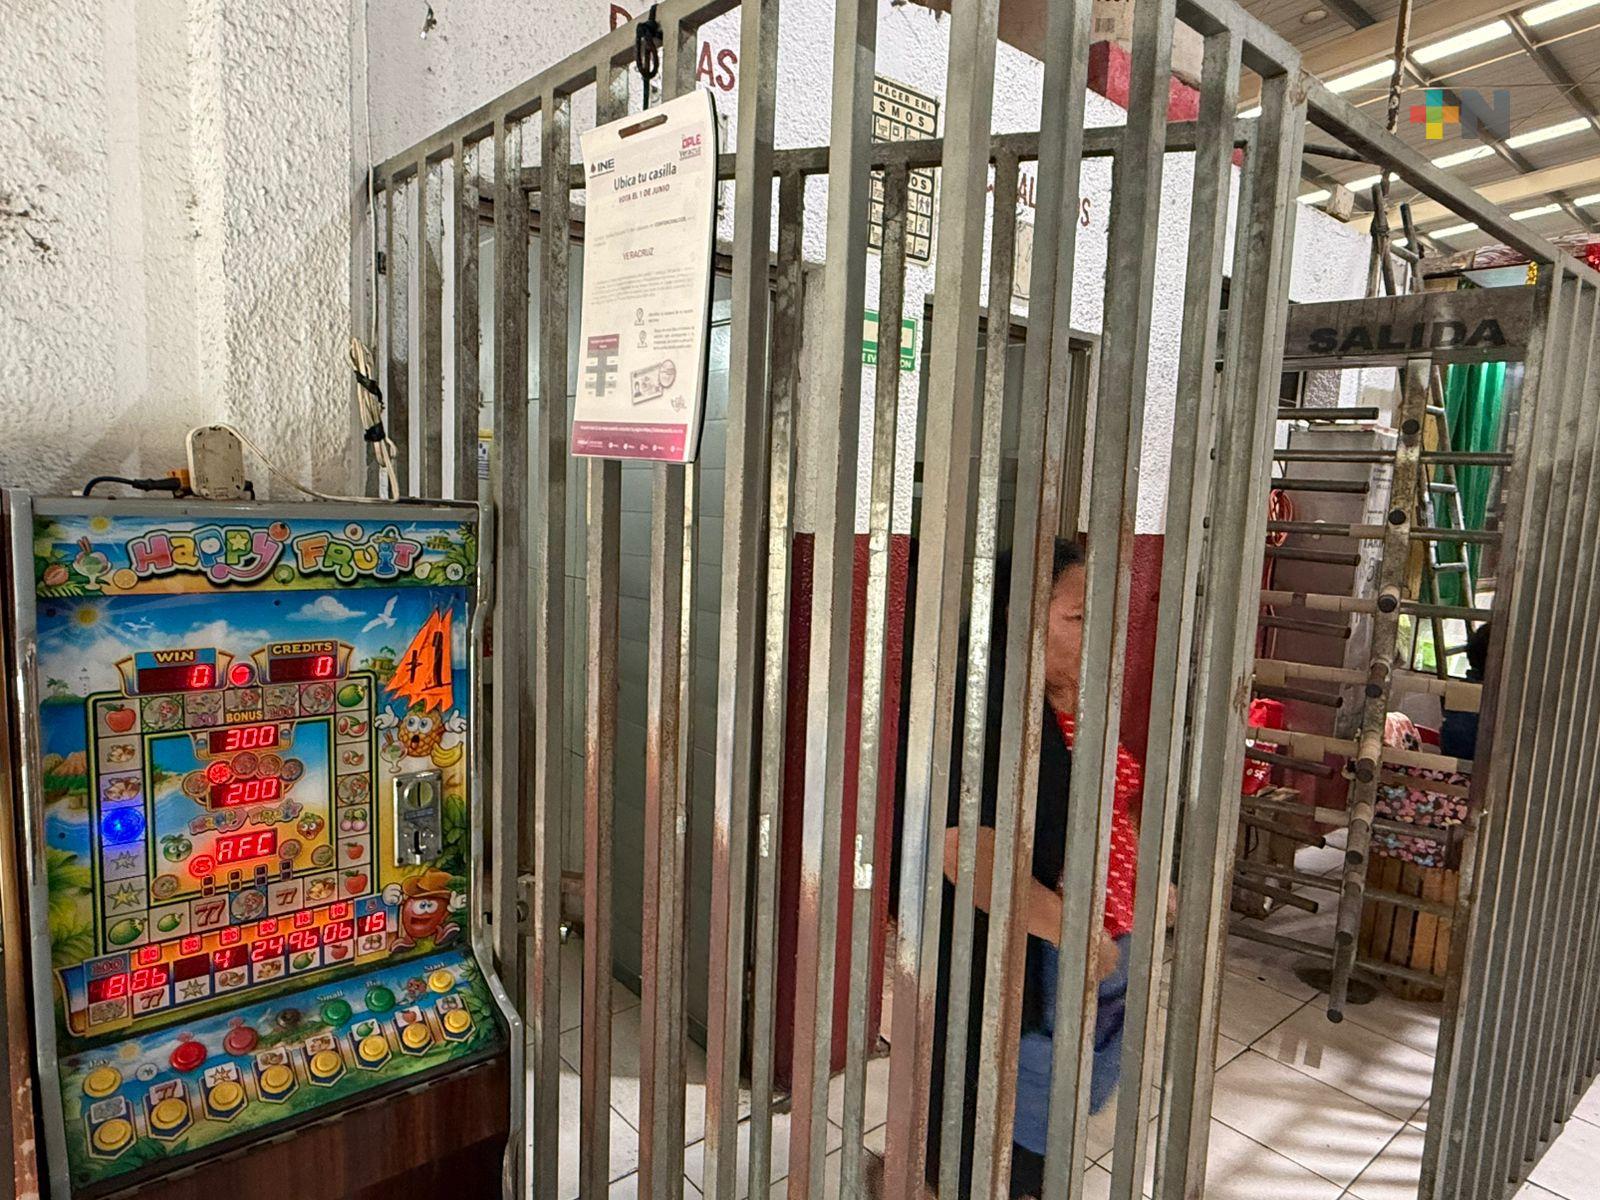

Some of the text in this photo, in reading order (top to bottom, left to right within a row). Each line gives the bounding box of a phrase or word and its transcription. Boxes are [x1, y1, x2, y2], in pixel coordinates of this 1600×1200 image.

[877, 83, 910, 104] HACER
[597, 158, 615, 172] INE
[613, 162, 677, 191] Ubica tu casilla
[643, 187, 651, 197] DE
[652, 183, 670, 195] JUNIO
[623, 247, 654, 260] VERACRUZ
[1308, 318, 1506, 352] SALIDA
[155, 650, 196, 663] WIN
[272, 642, 333, 655] CREDITS
[192, 664, 209, 687] 0
[316, 656, 332, 676] 0
[226, 710, 263, 723] BONUS
[225, 725, 274, 751] 300
[226, 778, 277, 804] 200
[218, 833, 272, 861] AFC
[195, 899, 226, 927] 77
[252, 937, 284, 961] 24
